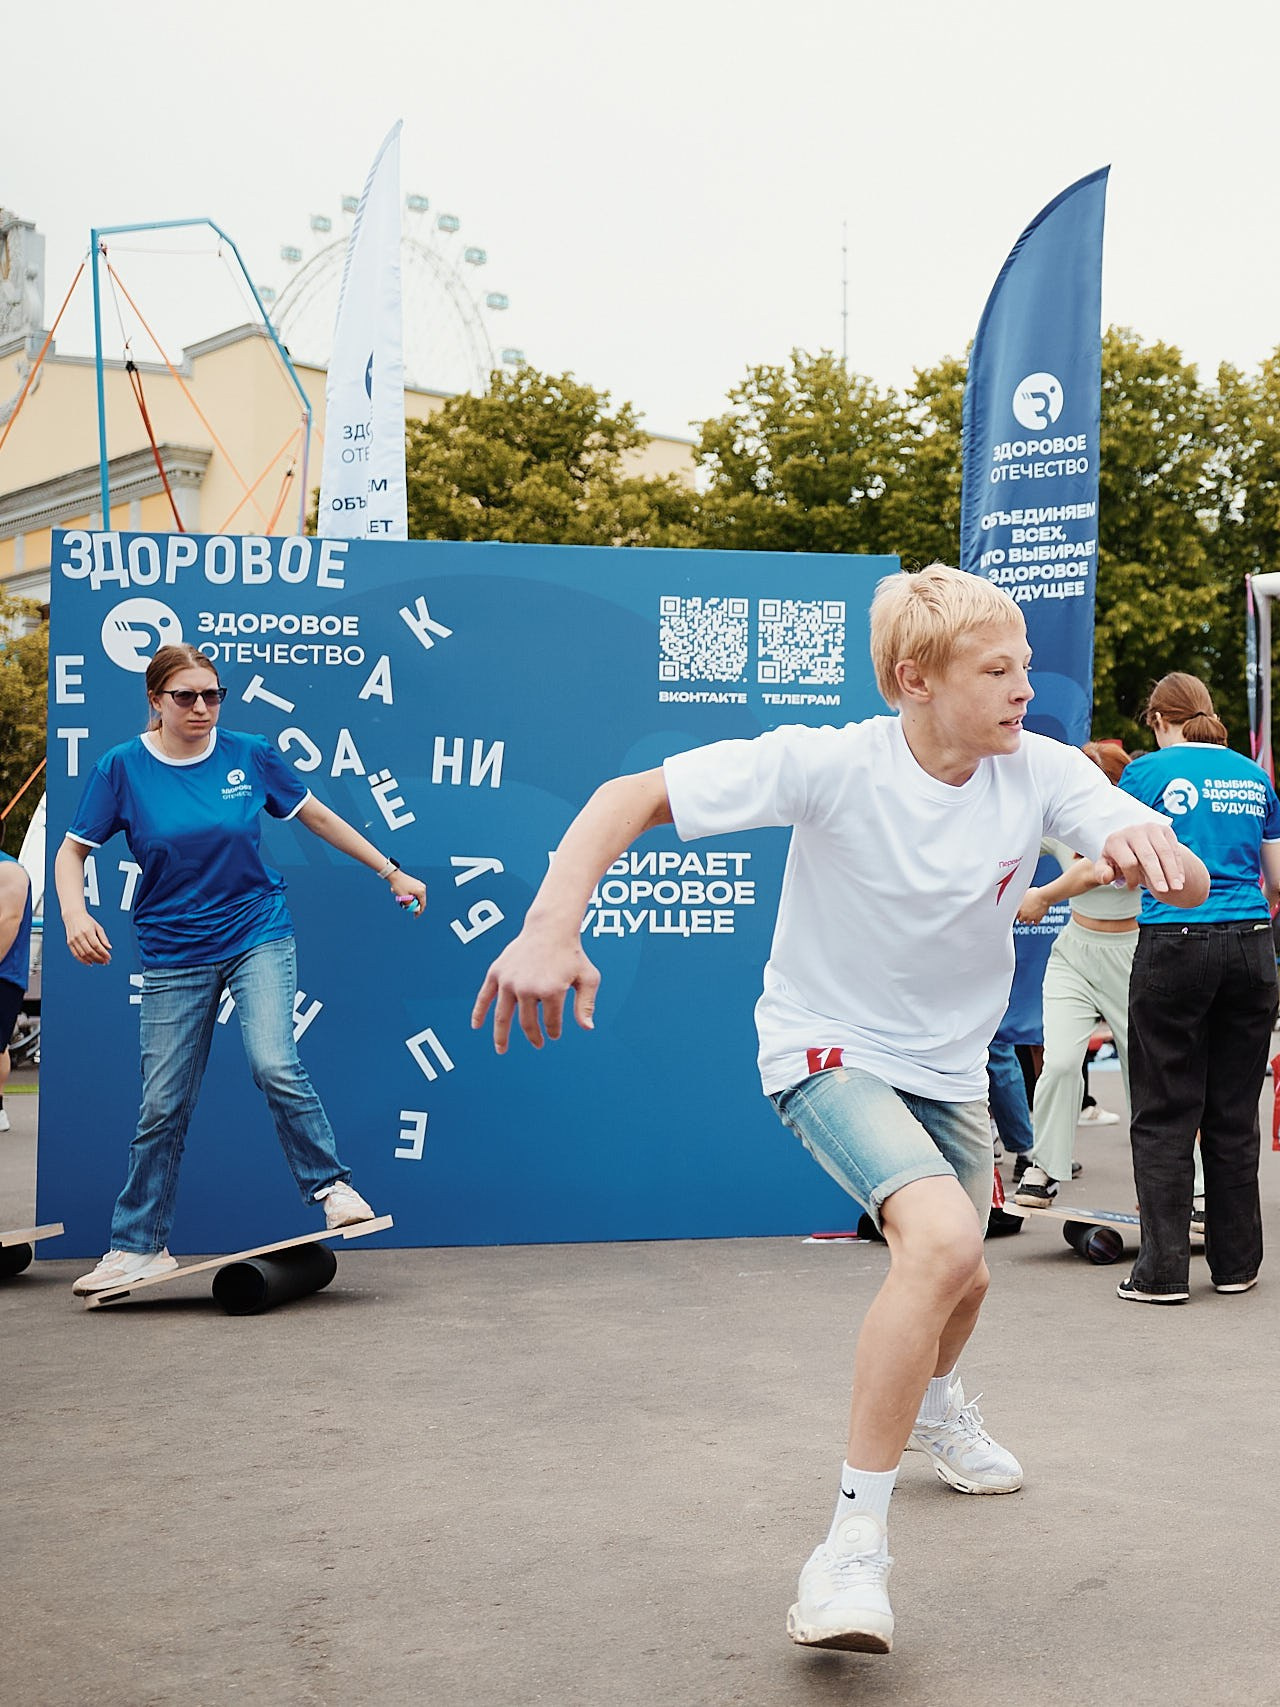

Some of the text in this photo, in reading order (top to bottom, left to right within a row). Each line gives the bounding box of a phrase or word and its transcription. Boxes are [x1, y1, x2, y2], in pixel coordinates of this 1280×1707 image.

[992, 434, 1087, 462] ЗДОРОВОЕ
[990, 457, 1089, 484] ОТЕЧЕСТВО
[981, 502, 1096, 530] ОБЪЕДИНЯЕМ
[1012, 526, 1067, 544] ВСЕХ,
[61, 530, 350, 589] ЗДОРОВОЕ
[988, 561, 1089, 584] ЗДОРОВОЕ
[998, 580, 1085, 602] УДУЩЕЕ
[198, 613, 358, 637] ЗДОРОВОЕ
[199, 642, 365, 666] ОТЕЧЕСТВО
[658, 691, 747, 704] ВКОНТАКТЕ
[762, 693, 840, 705] ТЕЛЕГРАМ
[1204, 779, 1212, 787] Я
[579, 909, 735, 938] УДУЩЕЕ
